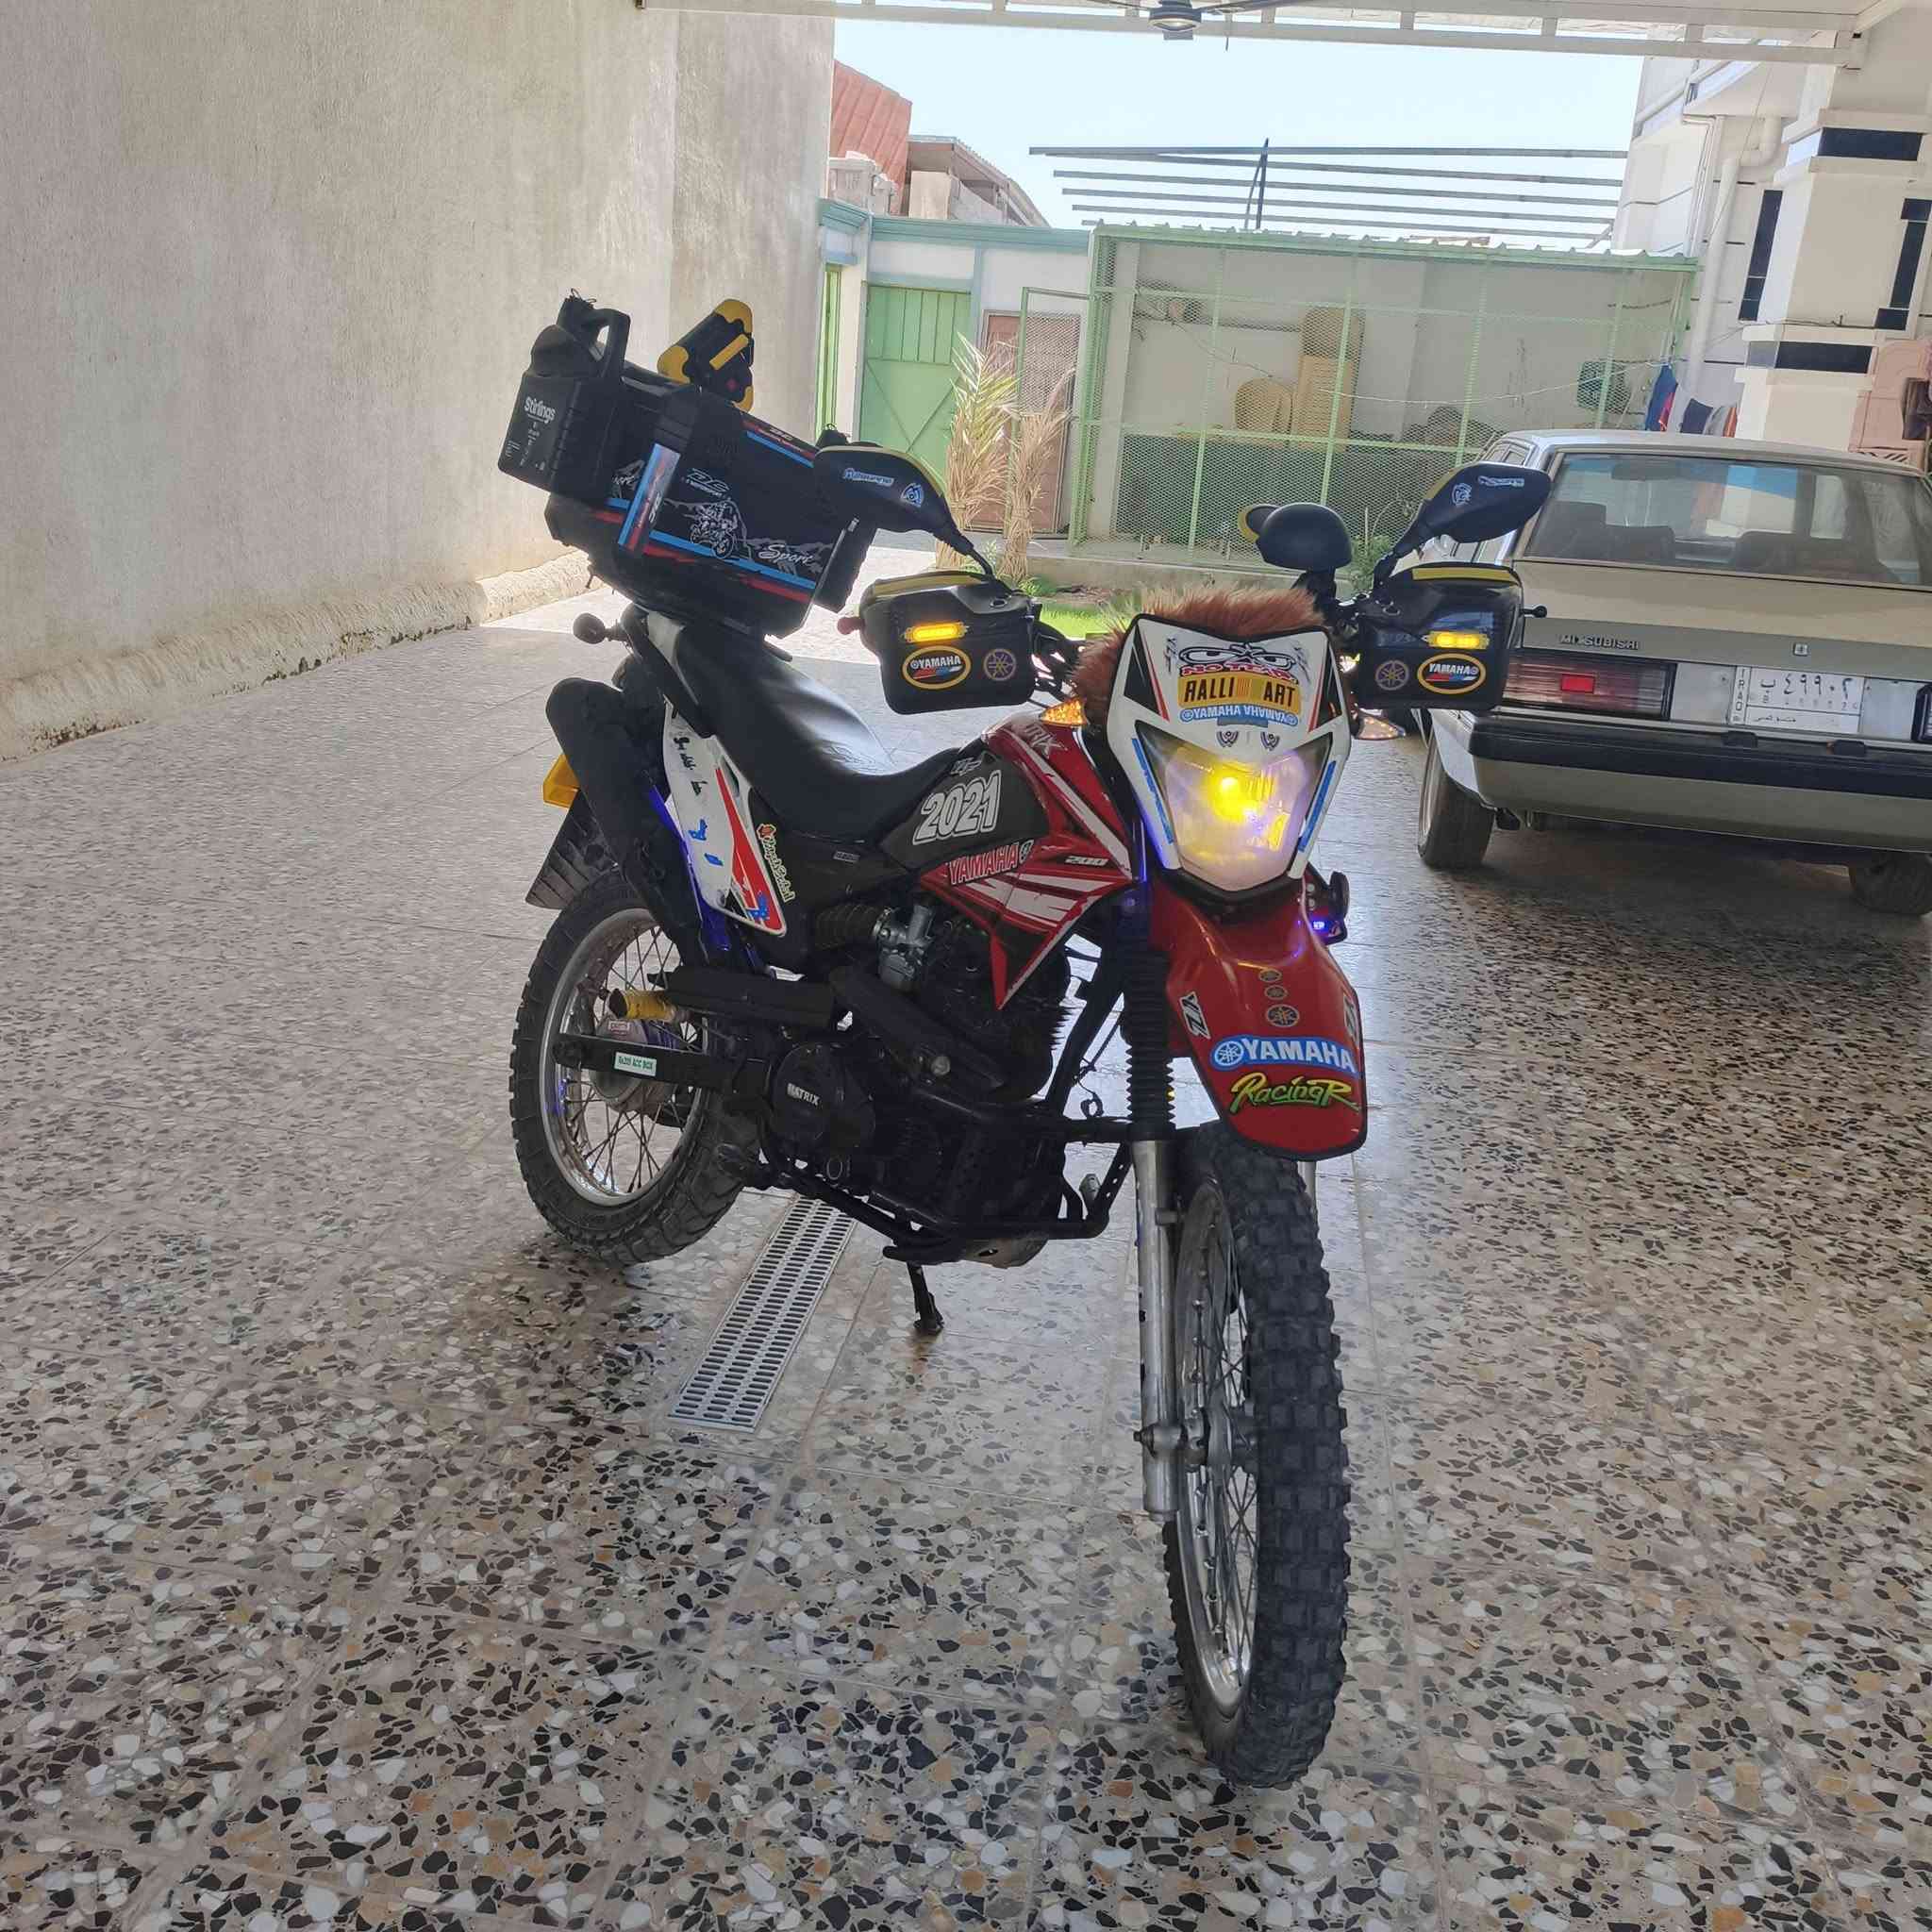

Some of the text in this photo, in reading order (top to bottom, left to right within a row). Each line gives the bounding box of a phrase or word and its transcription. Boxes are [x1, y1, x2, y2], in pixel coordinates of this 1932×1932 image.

[758, 544, 814, 563] Sport
[919, 656, 962, 669] YAMAHA
[1428, 662, 1471, 675] YAMAHA
[1184, 676, 1296, 708] RALLI ART
[1193, 705, 1241, 719] YAMAHA
[912, 770, 1003, 845] 2021
[948, 841, 1020, 886] YAMAHA
[1065, 856, 1110, 867] 200
[1242, 1038, 1357, 1074] YAMAHA
